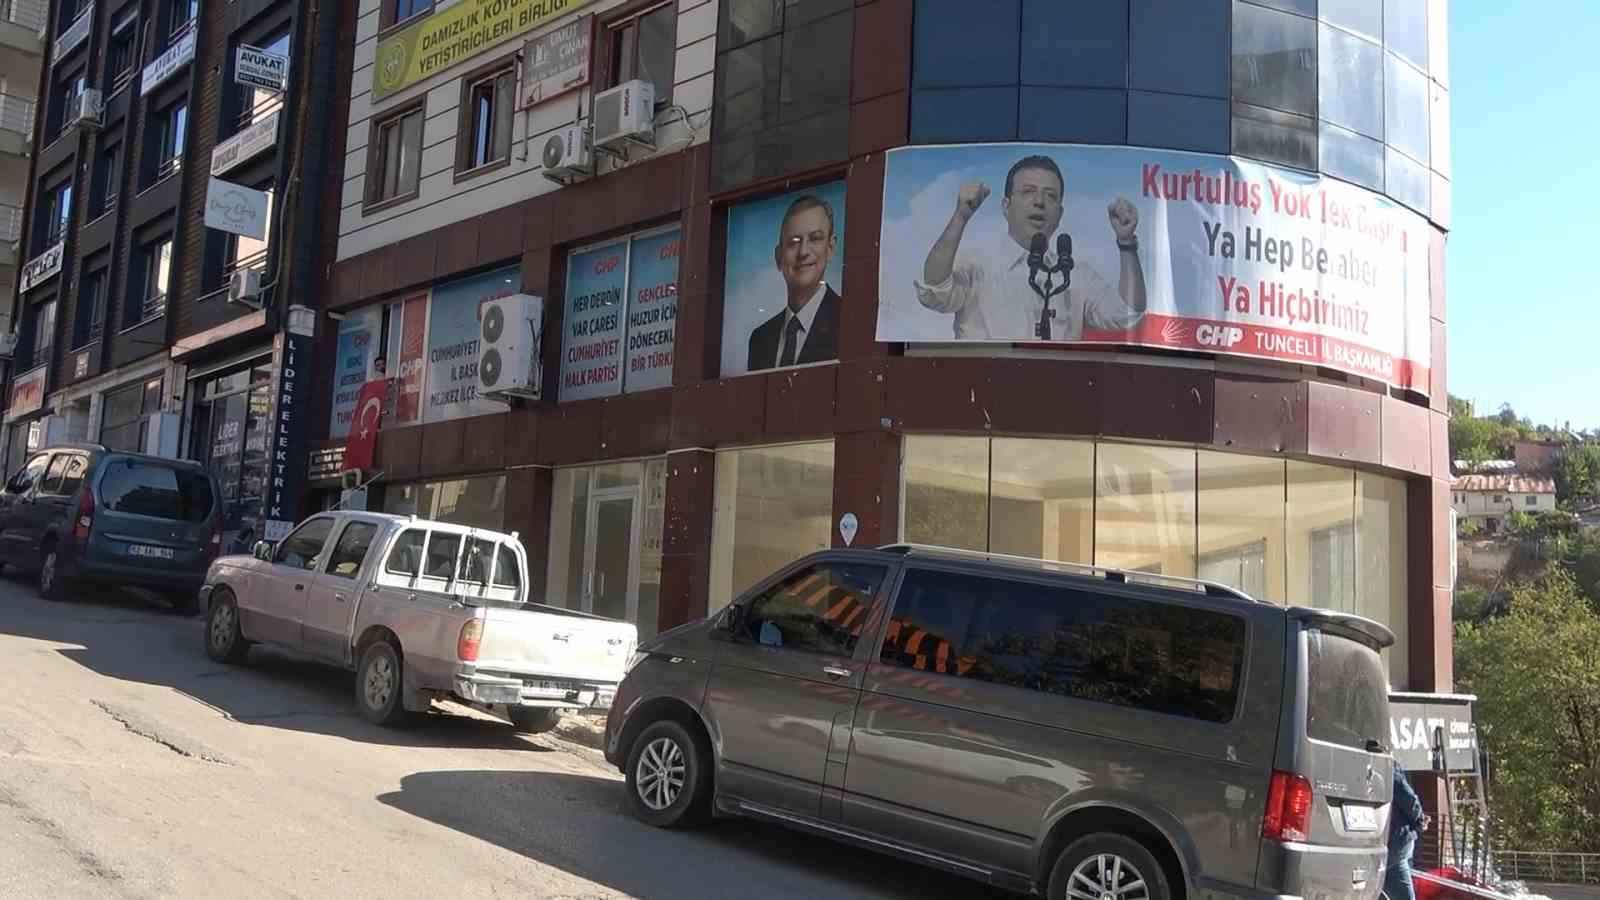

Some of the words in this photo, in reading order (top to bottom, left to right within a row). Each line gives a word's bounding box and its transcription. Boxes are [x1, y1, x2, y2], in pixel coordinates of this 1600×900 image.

[422, 12, 478, 51] DAMIZLIK
[241, 52, 282, 69] AVUKAT
[1142, 163, 1262, 215] Kurtuluş
[1268, 178, 1311, 218] Yok
[1203, 221, 1235, 259] Ya
[1245, 226, 1294, 272] Hep
[573, 294, 590, 313] HER
[1218, 275, 1250, 315] Ya
[1259, 280, 1369, 336] Hiçbirimiz
[572, 315, 588, 338] VAR
[589, 310, 619, 337] ÇARESİ
[630, 308, 659, 328] HUZUR
[568, 338, 620, 363] CUMHURİYET
[1196, 324, 1244, 347] CHP
[1255, 331, 1317, 357] TUNCELİ
[565, 367, 587, 389] HALK
[588, 362, 619, 385] PARTİSİ
[631, 354, 647, 373] BİR
